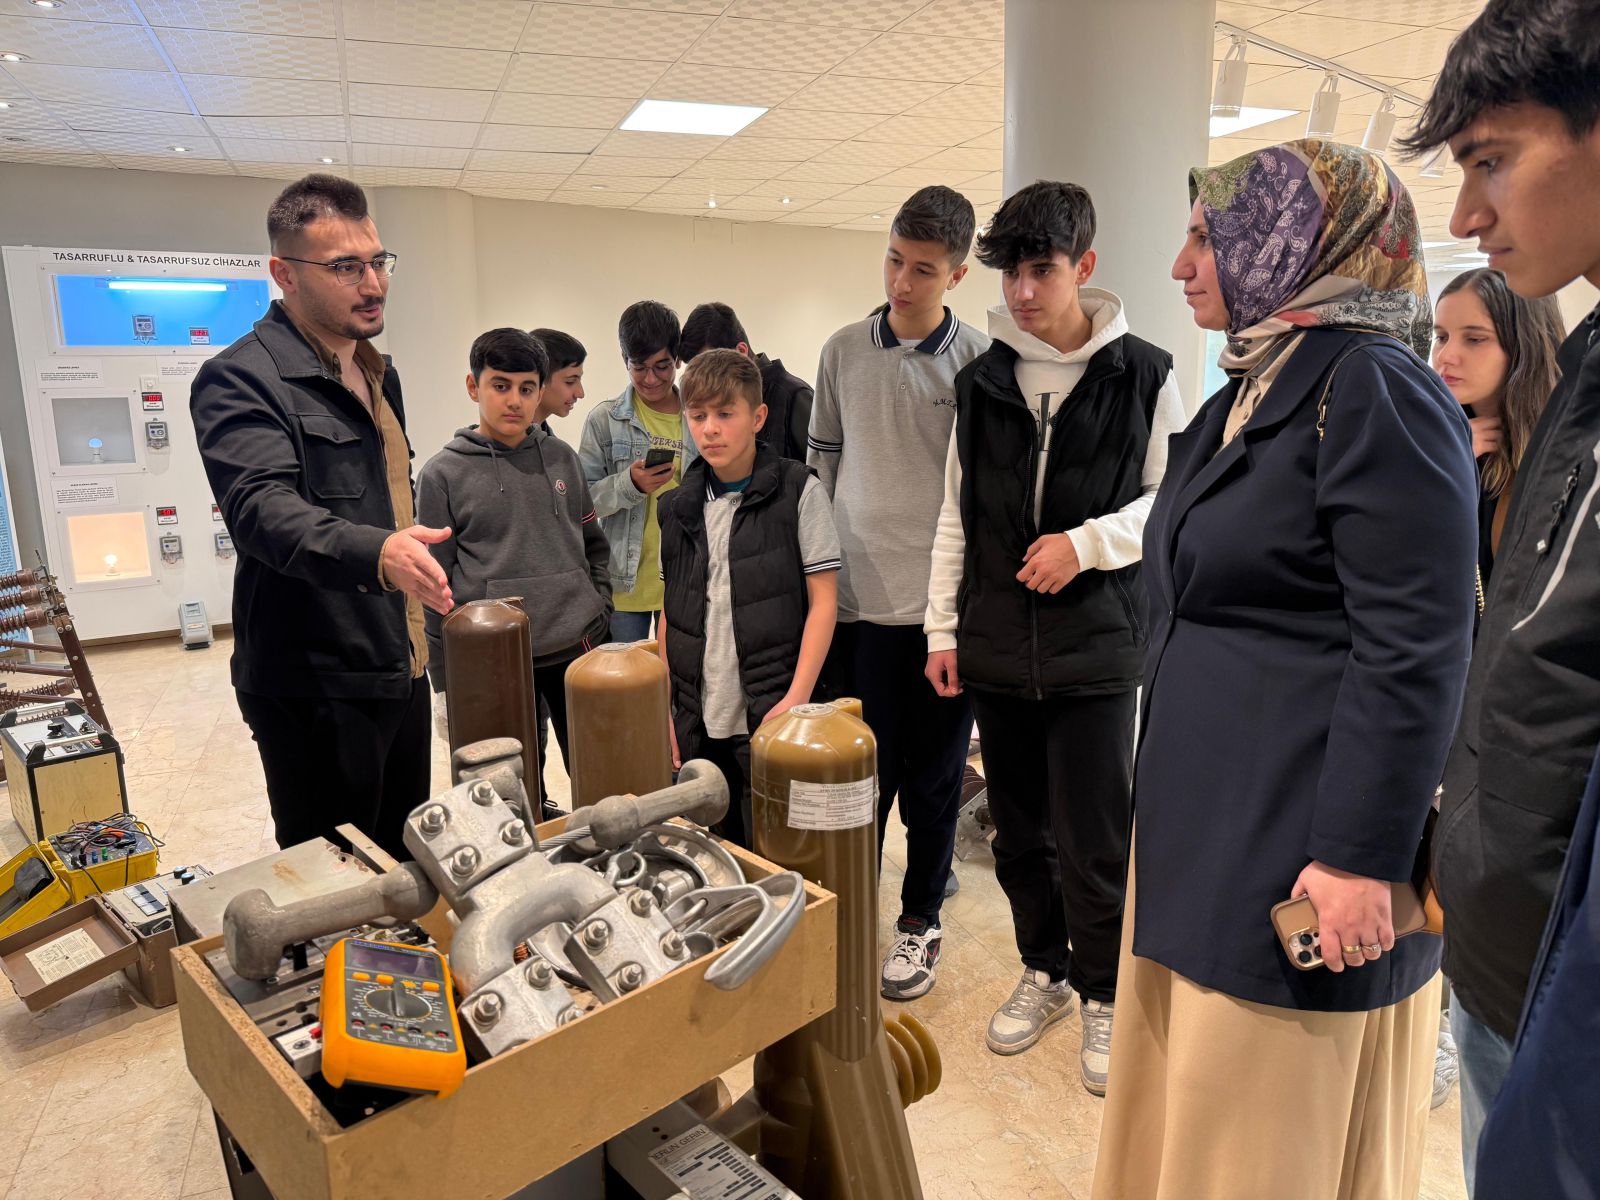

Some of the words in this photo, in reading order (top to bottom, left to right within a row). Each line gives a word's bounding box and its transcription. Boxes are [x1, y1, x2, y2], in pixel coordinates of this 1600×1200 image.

[53, 252, 124, 262] TASARRUFLU
[127, 255, 134, 263] &
[137, 255, 211, 266] TASARRUFSUZ
[213, 256, 261, 268] CİHAZLAR
